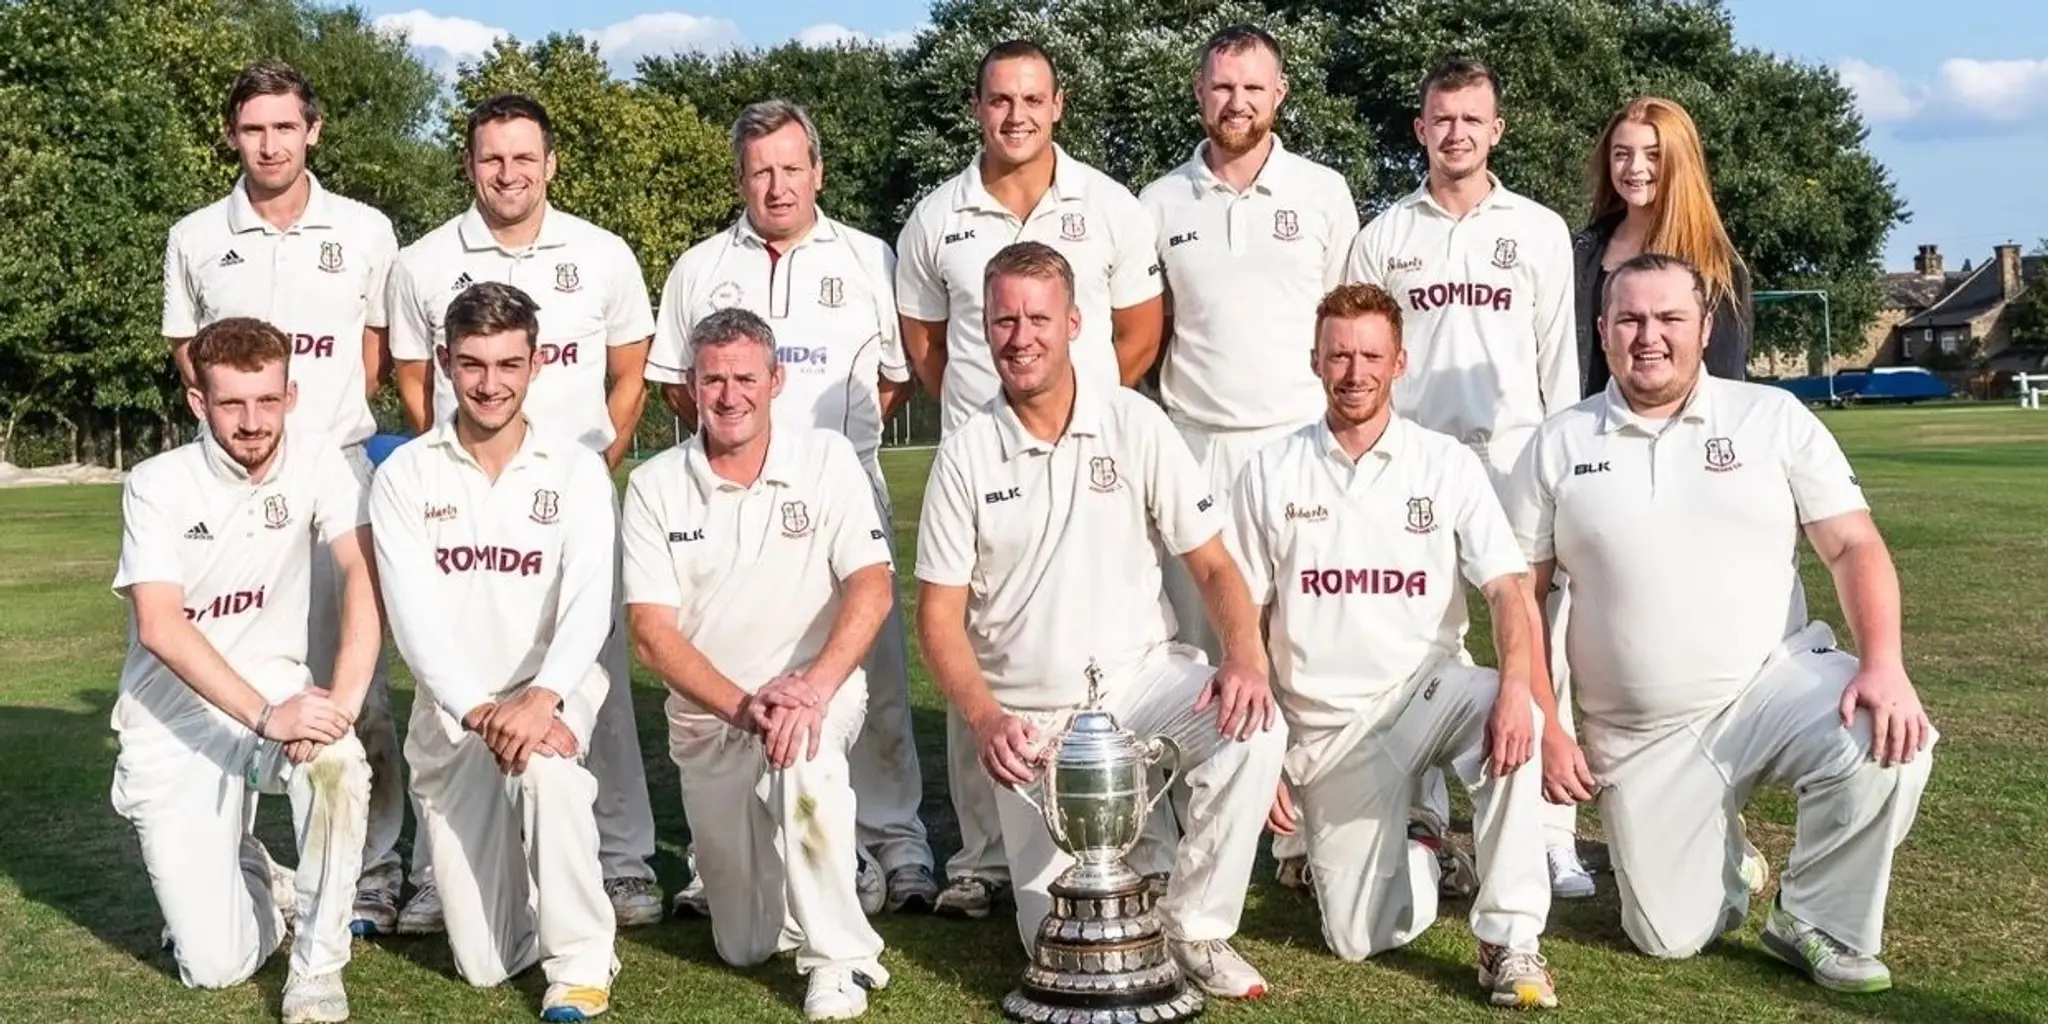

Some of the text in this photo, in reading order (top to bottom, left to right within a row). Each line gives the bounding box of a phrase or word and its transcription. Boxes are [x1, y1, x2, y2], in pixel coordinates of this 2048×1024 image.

[1169, 231, 1199, 247] BLK
[1408, 282, 1512, 311] ROMIDA
[1574, 460, 1611, 476] BLK
[985, 486, 1021, 504] BLK
[669, 528, 705, 542] BLK
[436, 545, 543, 577] ROMIDA
[1301, 568, 1427, 598] ROMIDA
